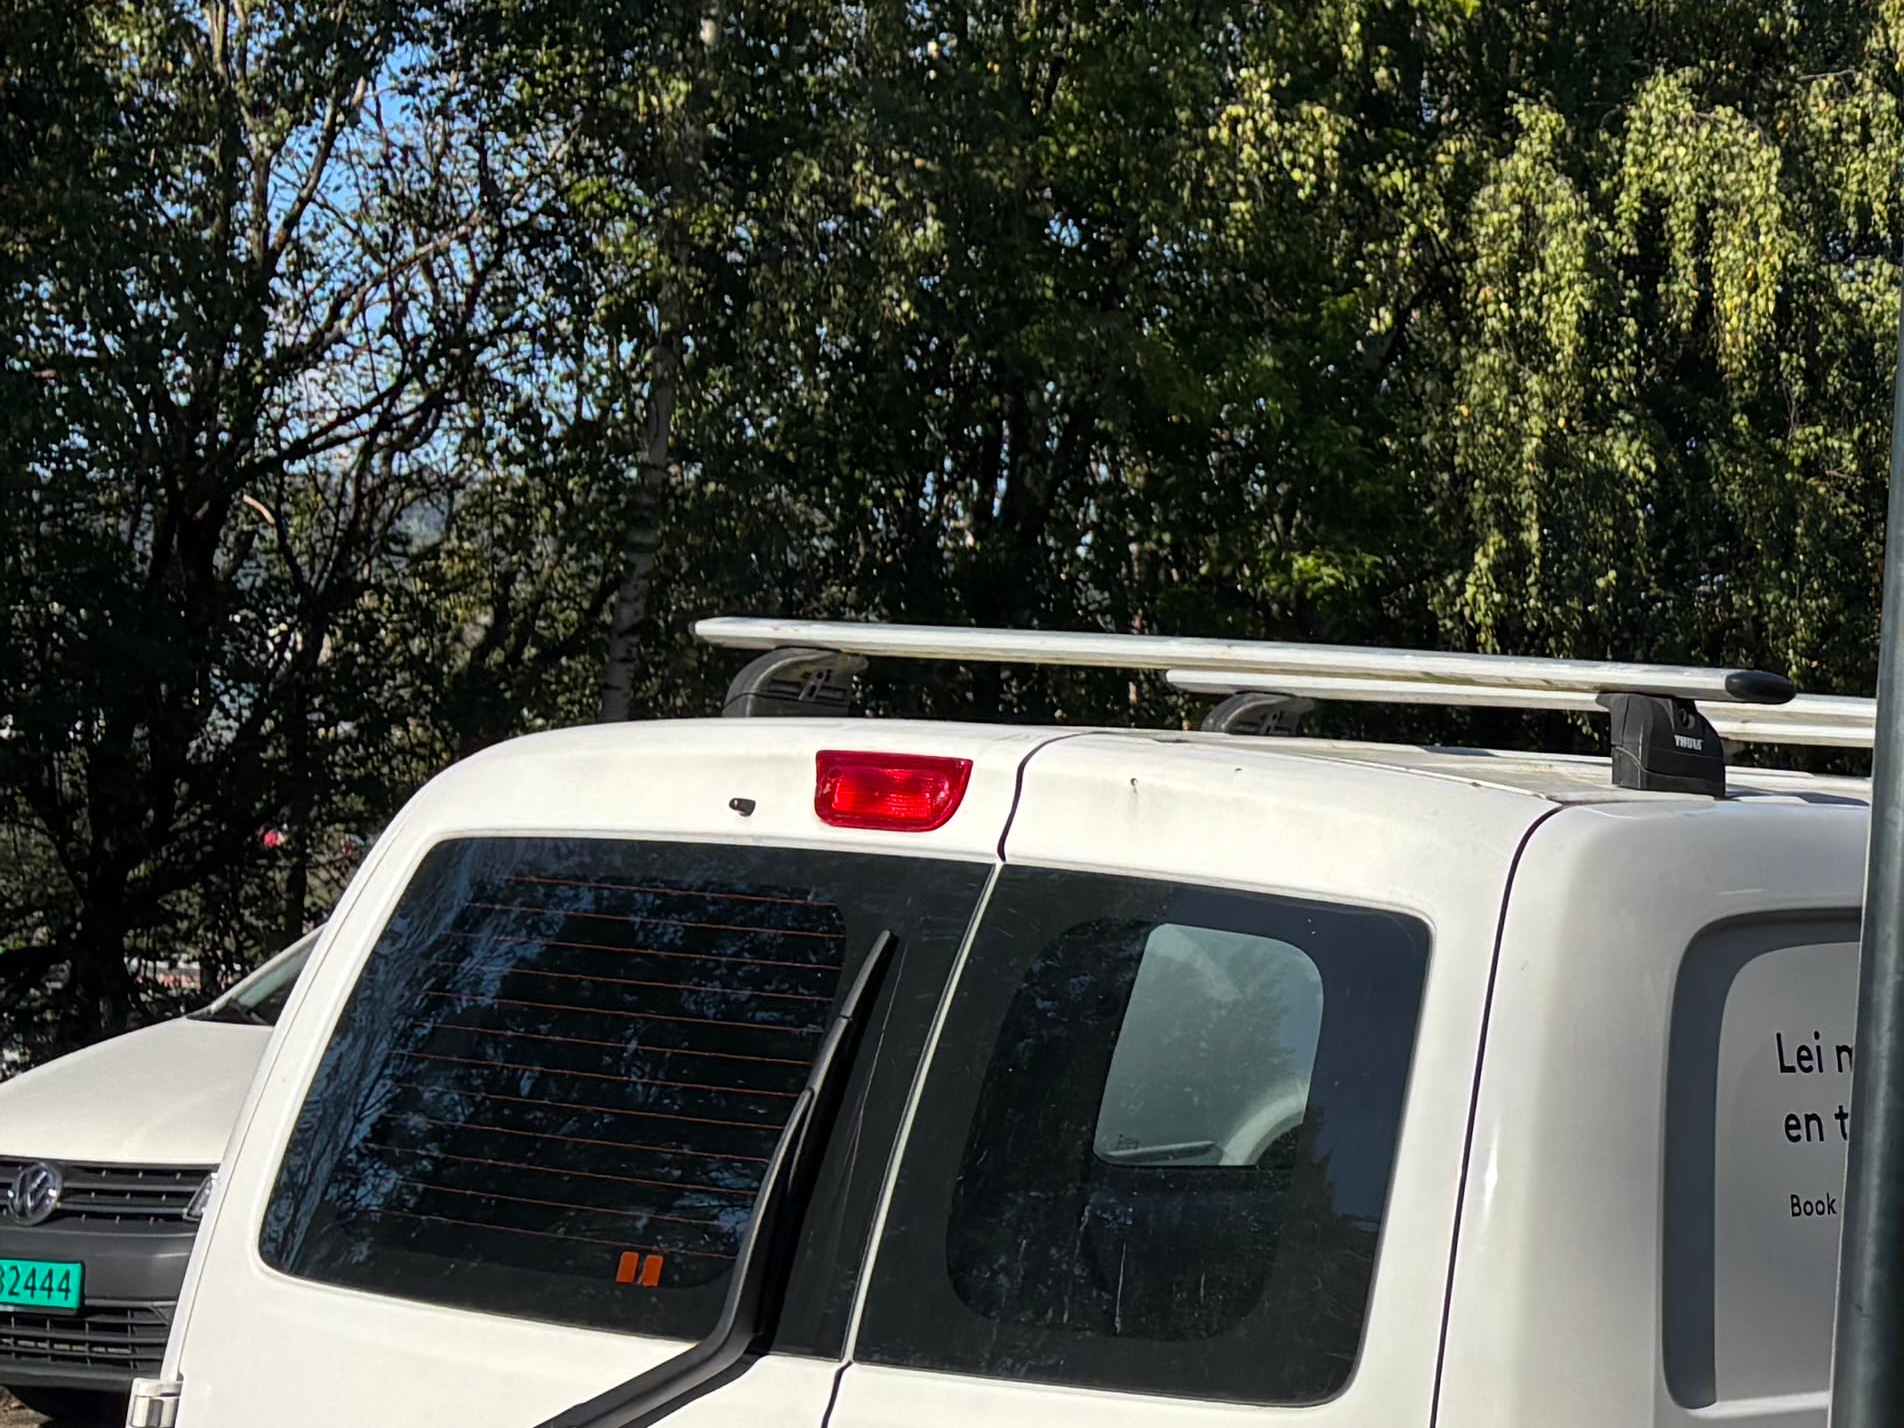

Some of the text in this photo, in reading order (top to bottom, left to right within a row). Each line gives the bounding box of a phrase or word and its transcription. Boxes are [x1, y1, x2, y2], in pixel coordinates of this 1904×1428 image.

[1775, 1030, 1824, 1073] Lei
[1784, 1112, 1824, 1143] en
[1790, 1192, 1837, 1217] Book
